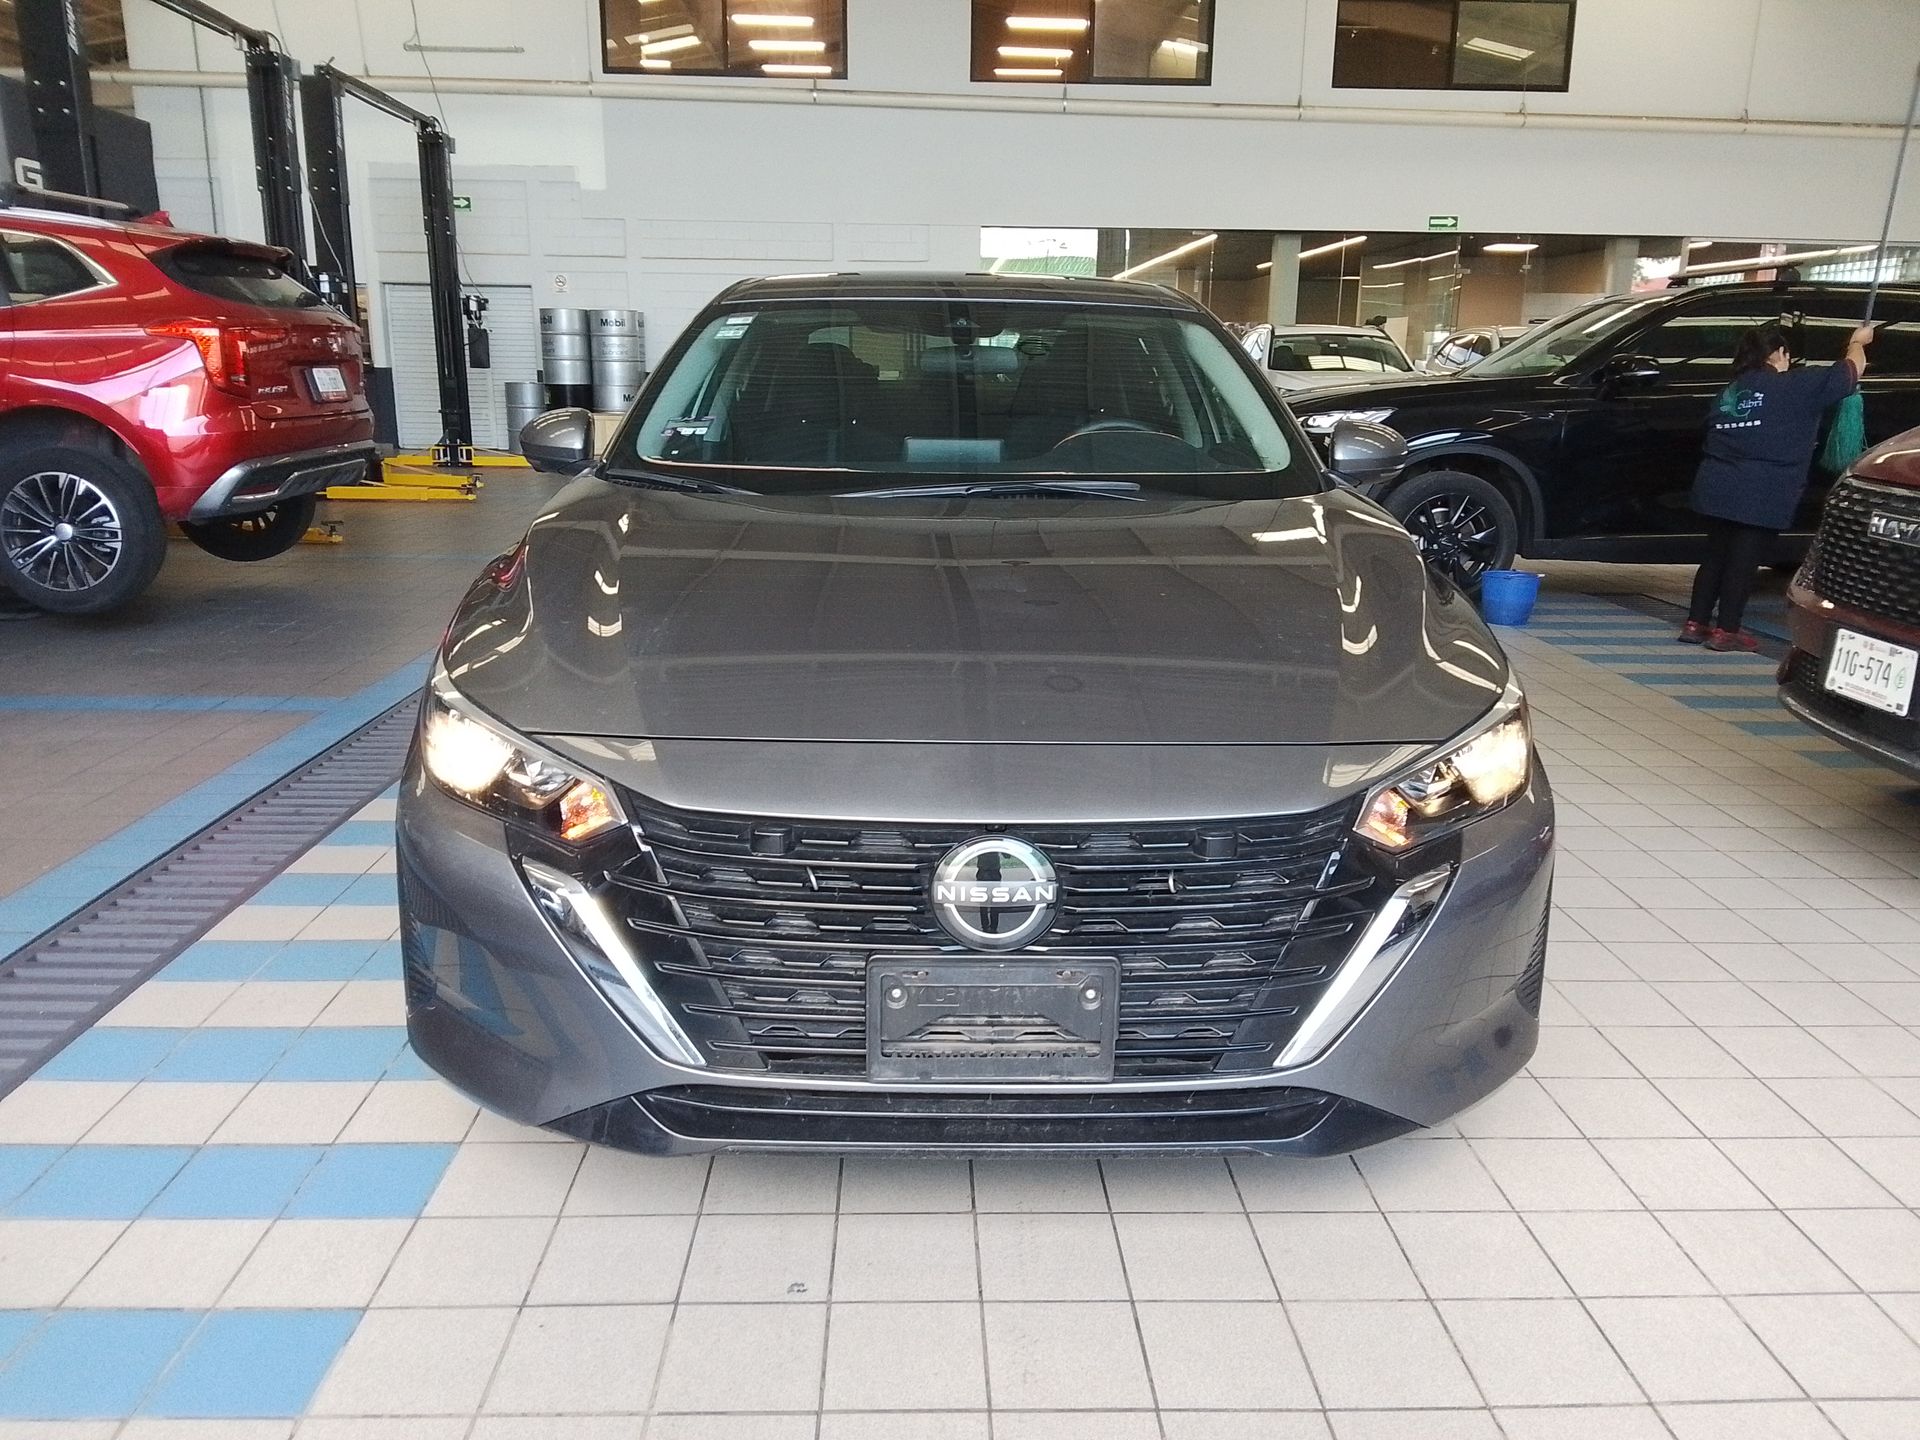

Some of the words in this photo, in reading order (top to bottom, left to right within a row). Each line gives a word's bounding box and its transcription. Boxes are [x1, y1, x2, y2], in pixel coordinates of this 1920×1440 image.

[600, 318, 626, 328] Mobil
[1834, 647, 1893, 689] 11G-574
[937, 884, 1054, 903] NISSAN
